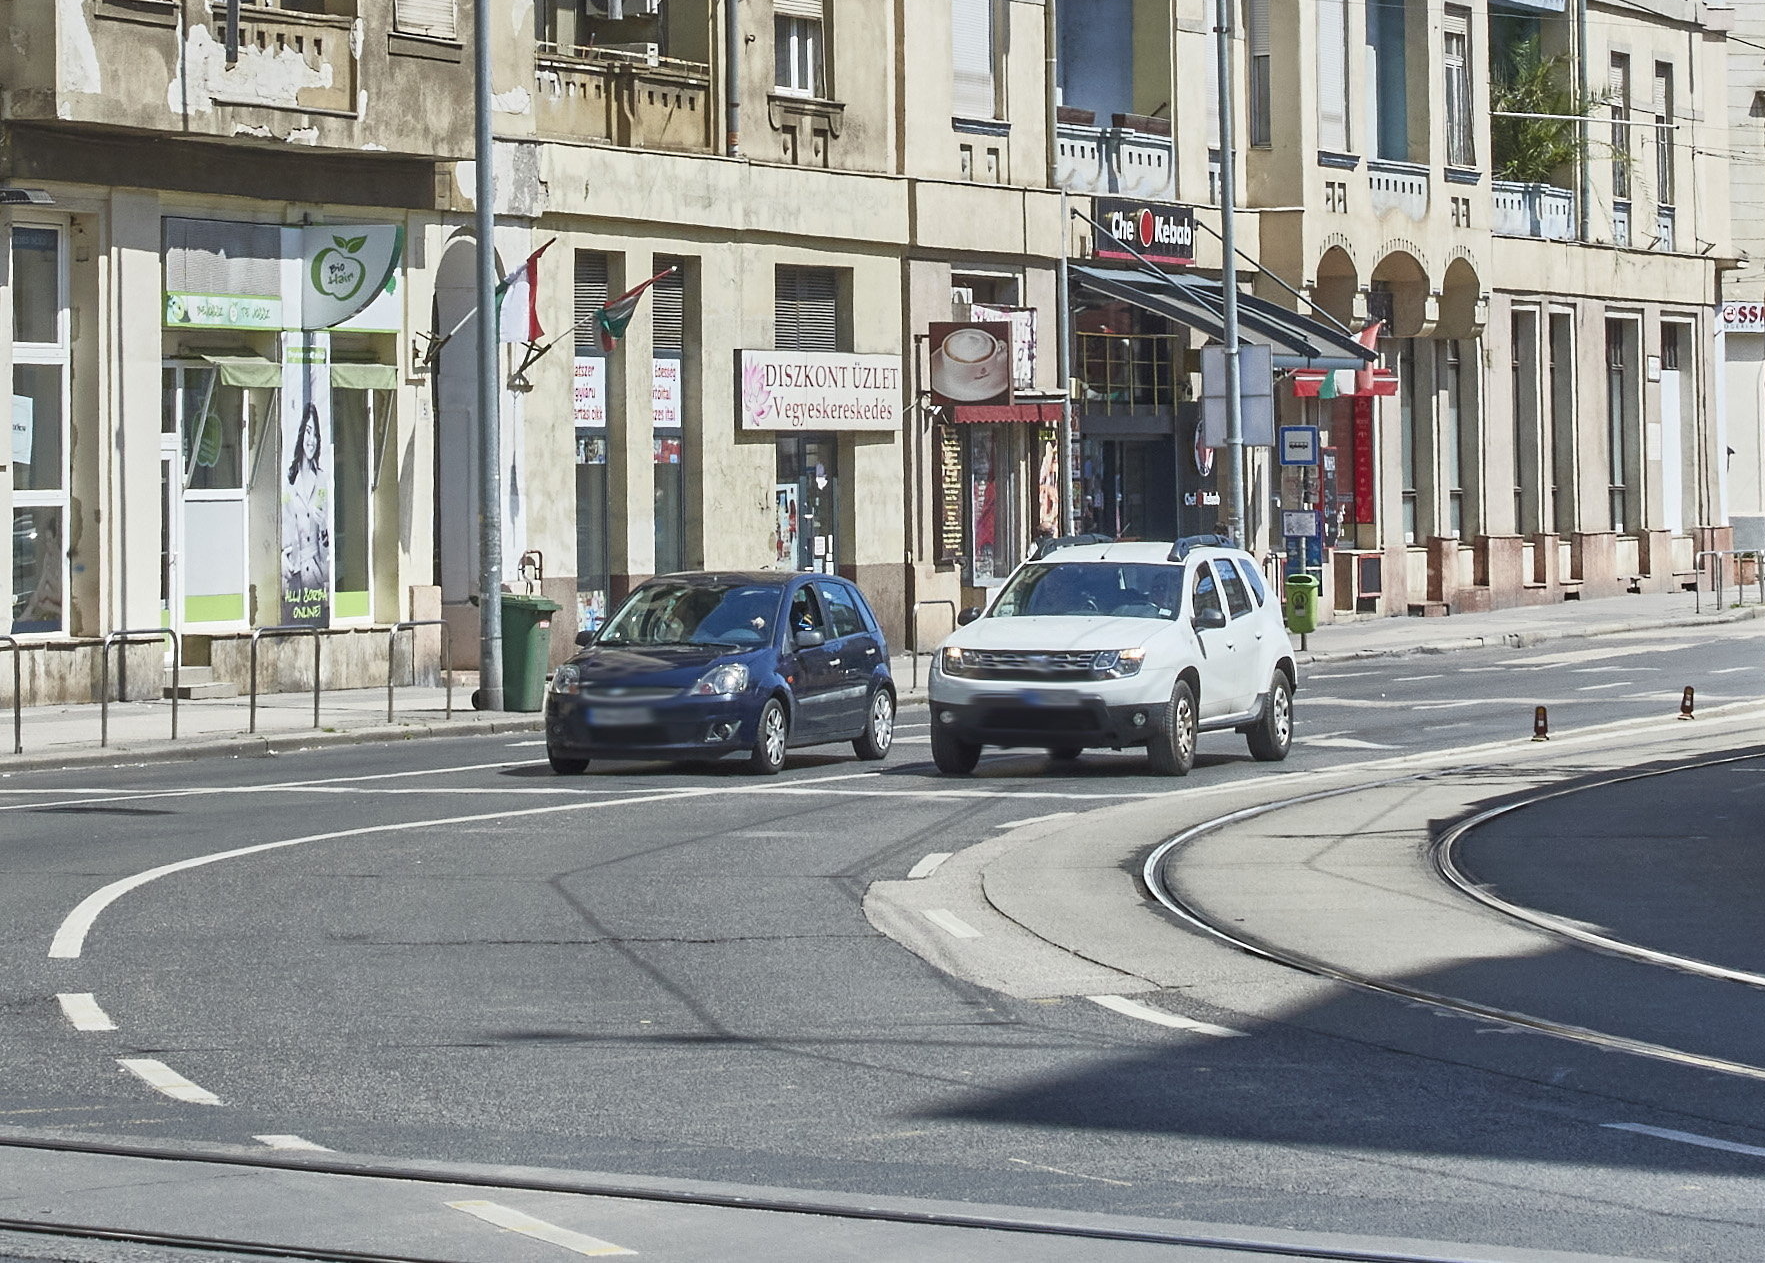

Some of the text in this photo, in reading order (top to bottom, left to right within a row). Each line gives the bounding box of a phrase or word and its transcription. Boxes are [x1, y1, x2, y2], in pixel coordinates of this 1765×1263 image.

[1154, 215, 1192, 246] Kebab
[328, 272, 354, 284] Hair
[329, 263, 345, 274] Bio
[765, 362, 899, 390] DISZKONT ÜZLET
[773, 396, 893, 427] Vegyeskereskedés
